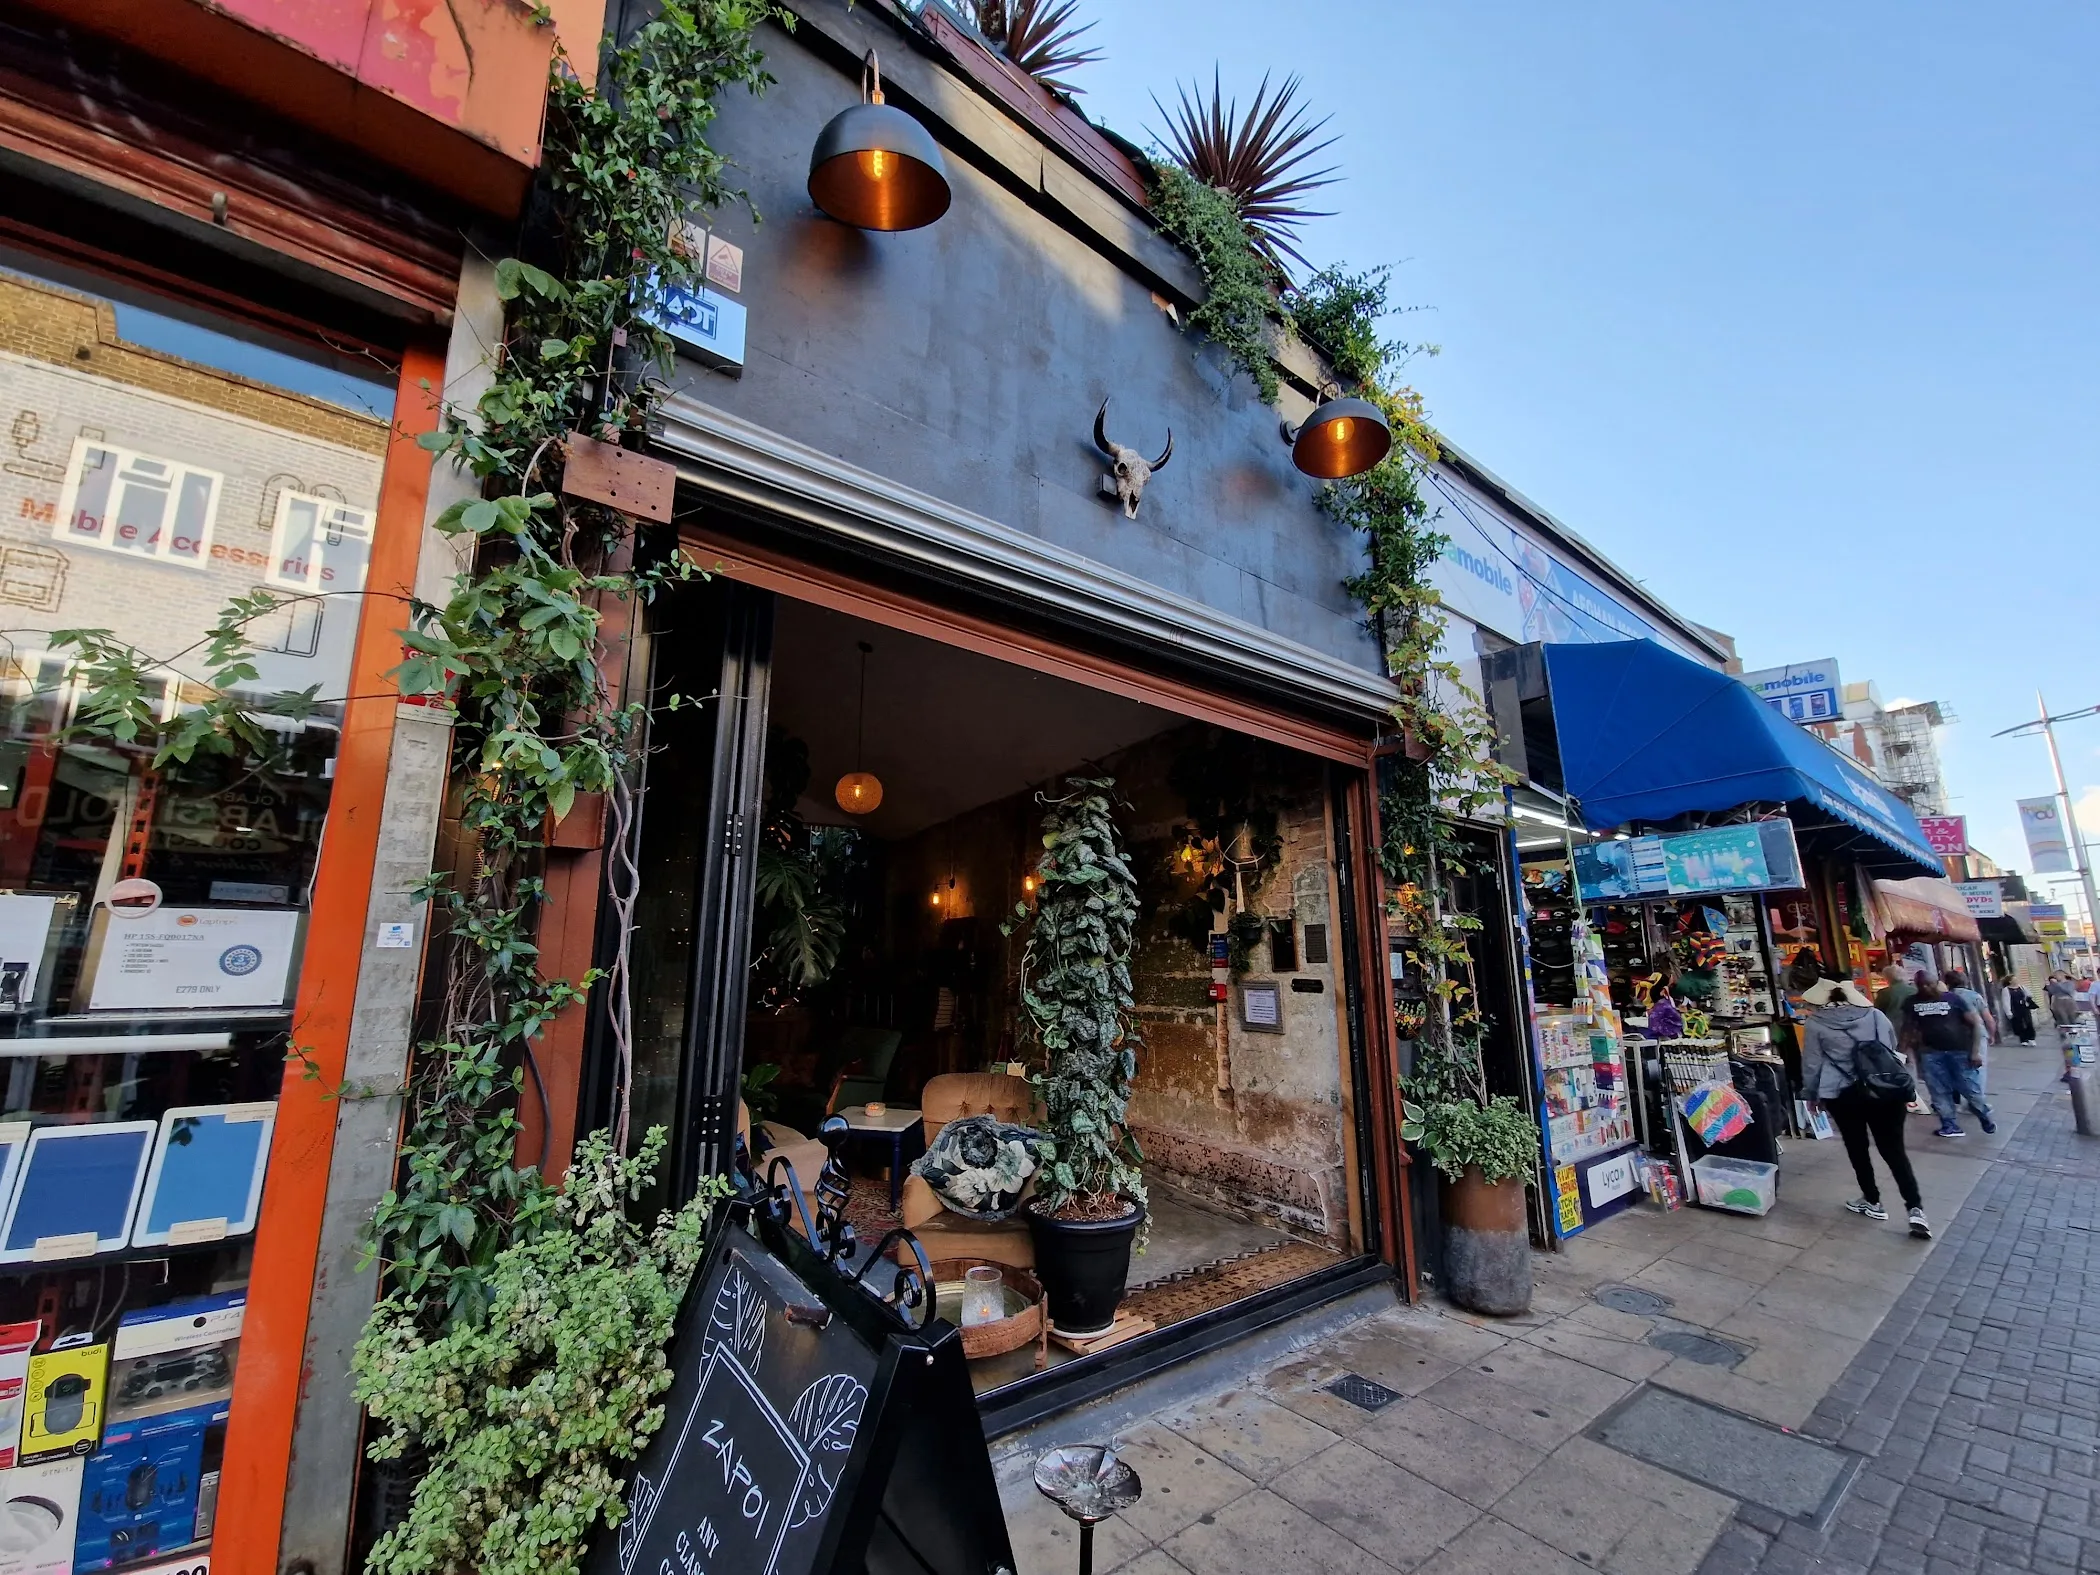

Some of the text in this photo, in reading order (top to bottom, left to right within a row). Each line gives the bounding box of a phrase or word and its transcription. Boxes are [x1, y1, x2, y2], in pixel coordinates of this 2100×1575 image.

[1966, 896, 1994, 904] DVDs
[199, 985, 221, 994] ONLY
[210, 1311, 241, 1323] PS4
[174, 1326, 238, 1343] Wireless Controller
[81, 1348, 102, 1357] budi
[697, 1516, 720, 1559] ANY
